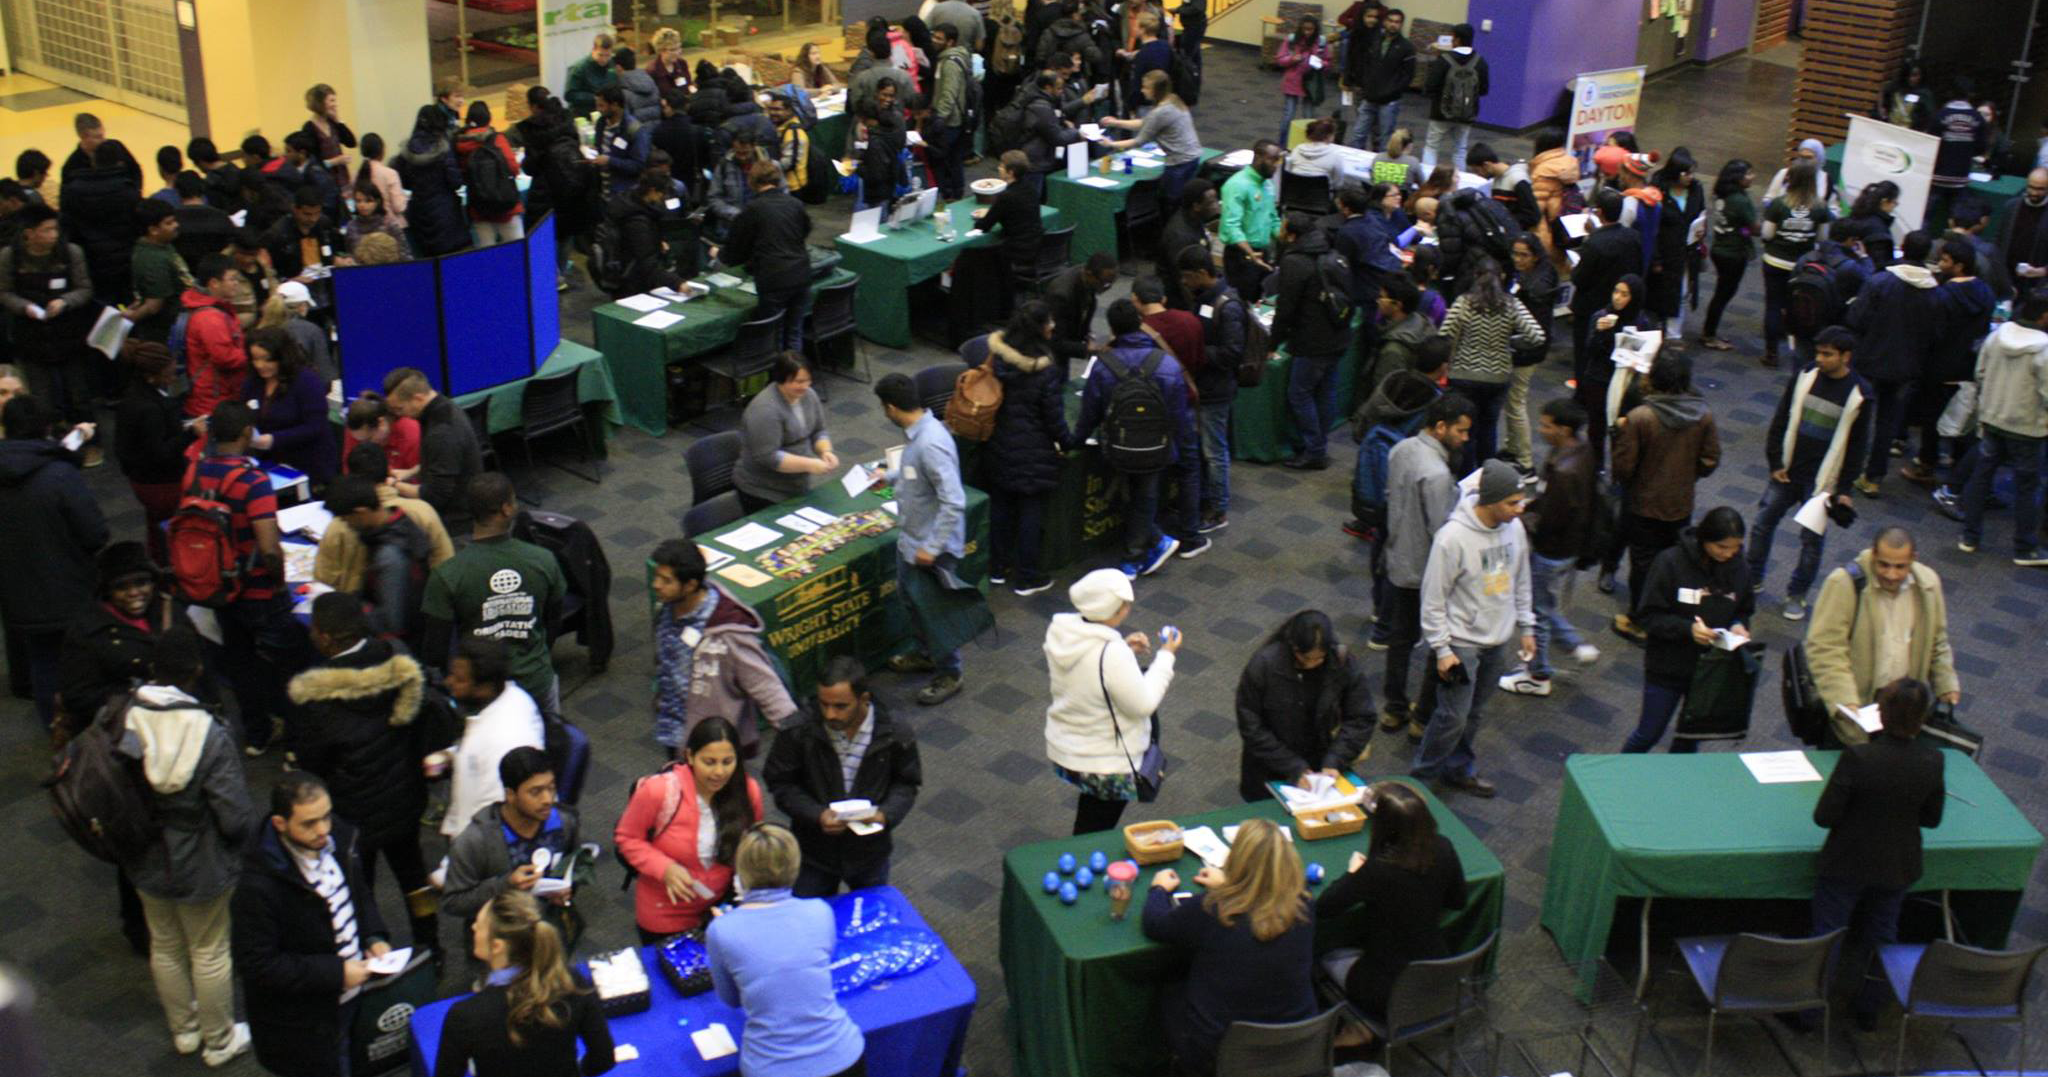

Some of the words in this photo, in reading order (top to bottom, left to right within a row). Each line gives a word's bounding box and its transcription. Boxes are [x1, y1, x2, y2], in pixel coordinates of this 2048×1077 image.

[544, 3, 608, 26] rta
[1576, 103, 1634, 126] DAYTON
[768, 609, 829, 647] WRIGHT
[831, 591, 871, 620] STATE
